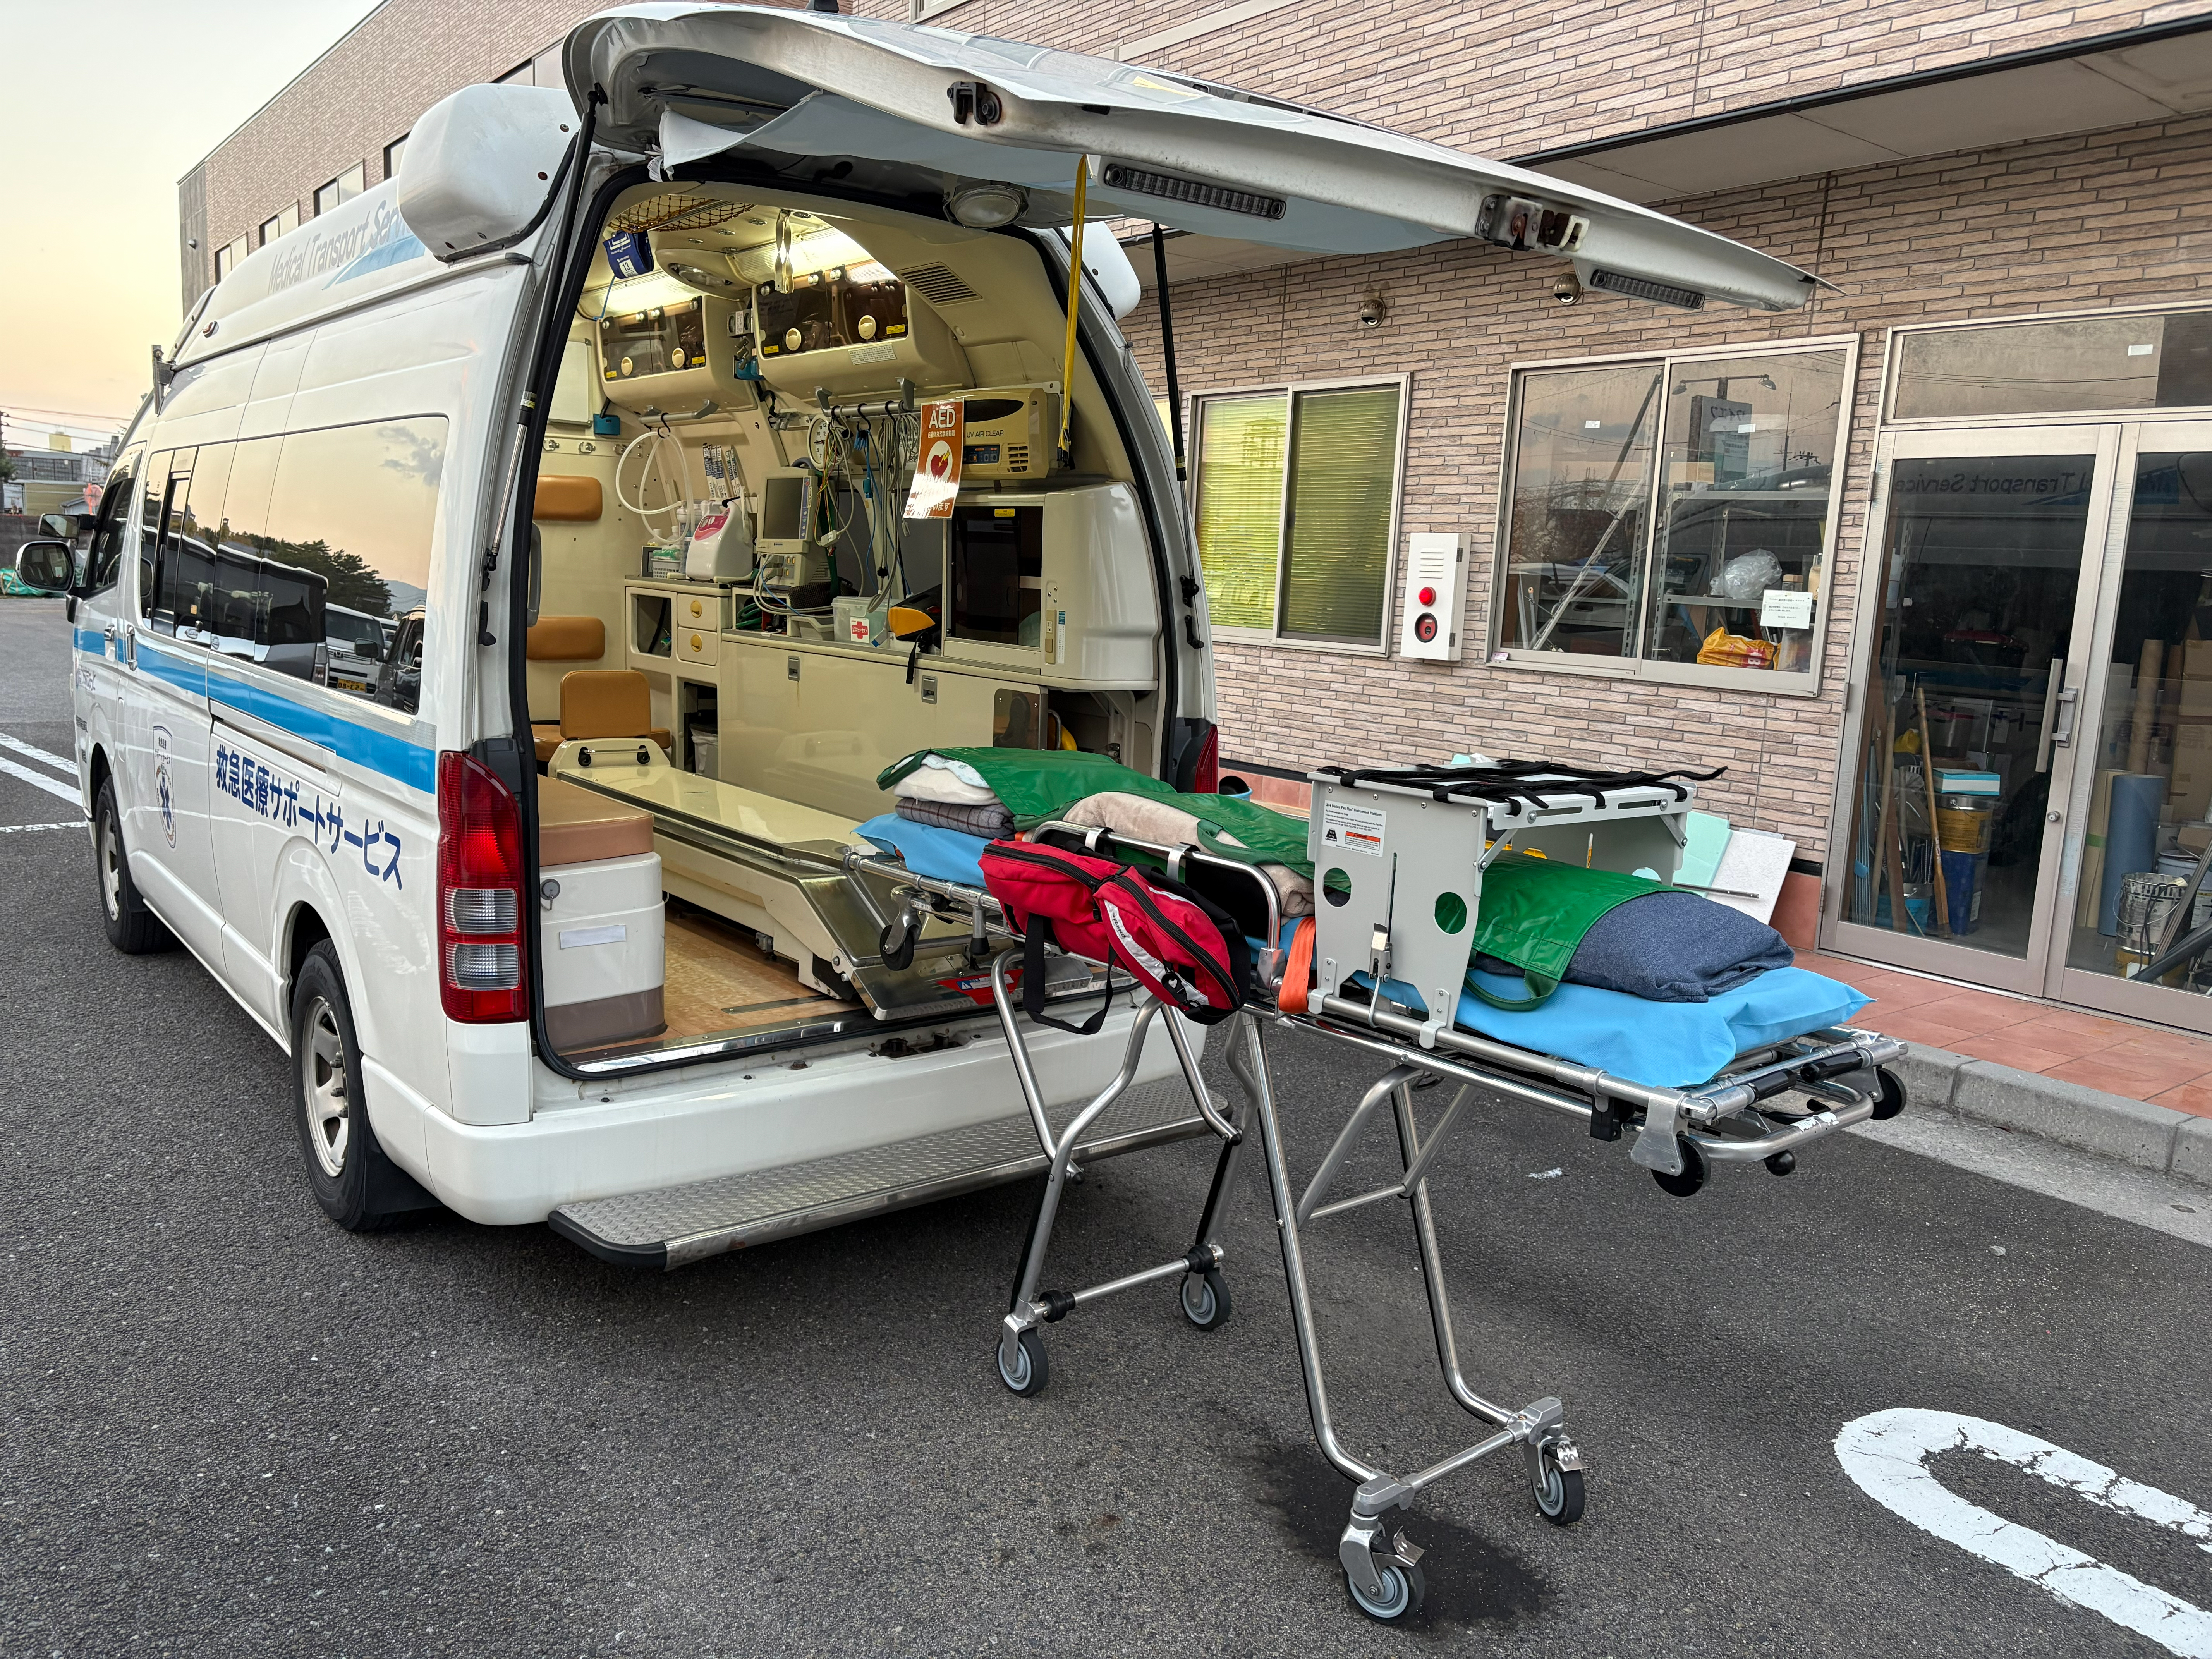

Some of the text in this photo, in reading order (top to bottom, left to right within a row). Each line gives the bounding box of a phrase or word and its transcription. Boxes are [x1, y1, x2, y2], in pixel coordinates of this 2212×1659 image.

[268, 237, 311, 295] Medical
[307, 211, 370, 277] Transport
[622, 262, 630, 271] 13
[928, 408, 956, 429] AED
[216, 744, 402, 891] 救急医療サポートサービス
[1113, 918, 1126, 938] FERNO
